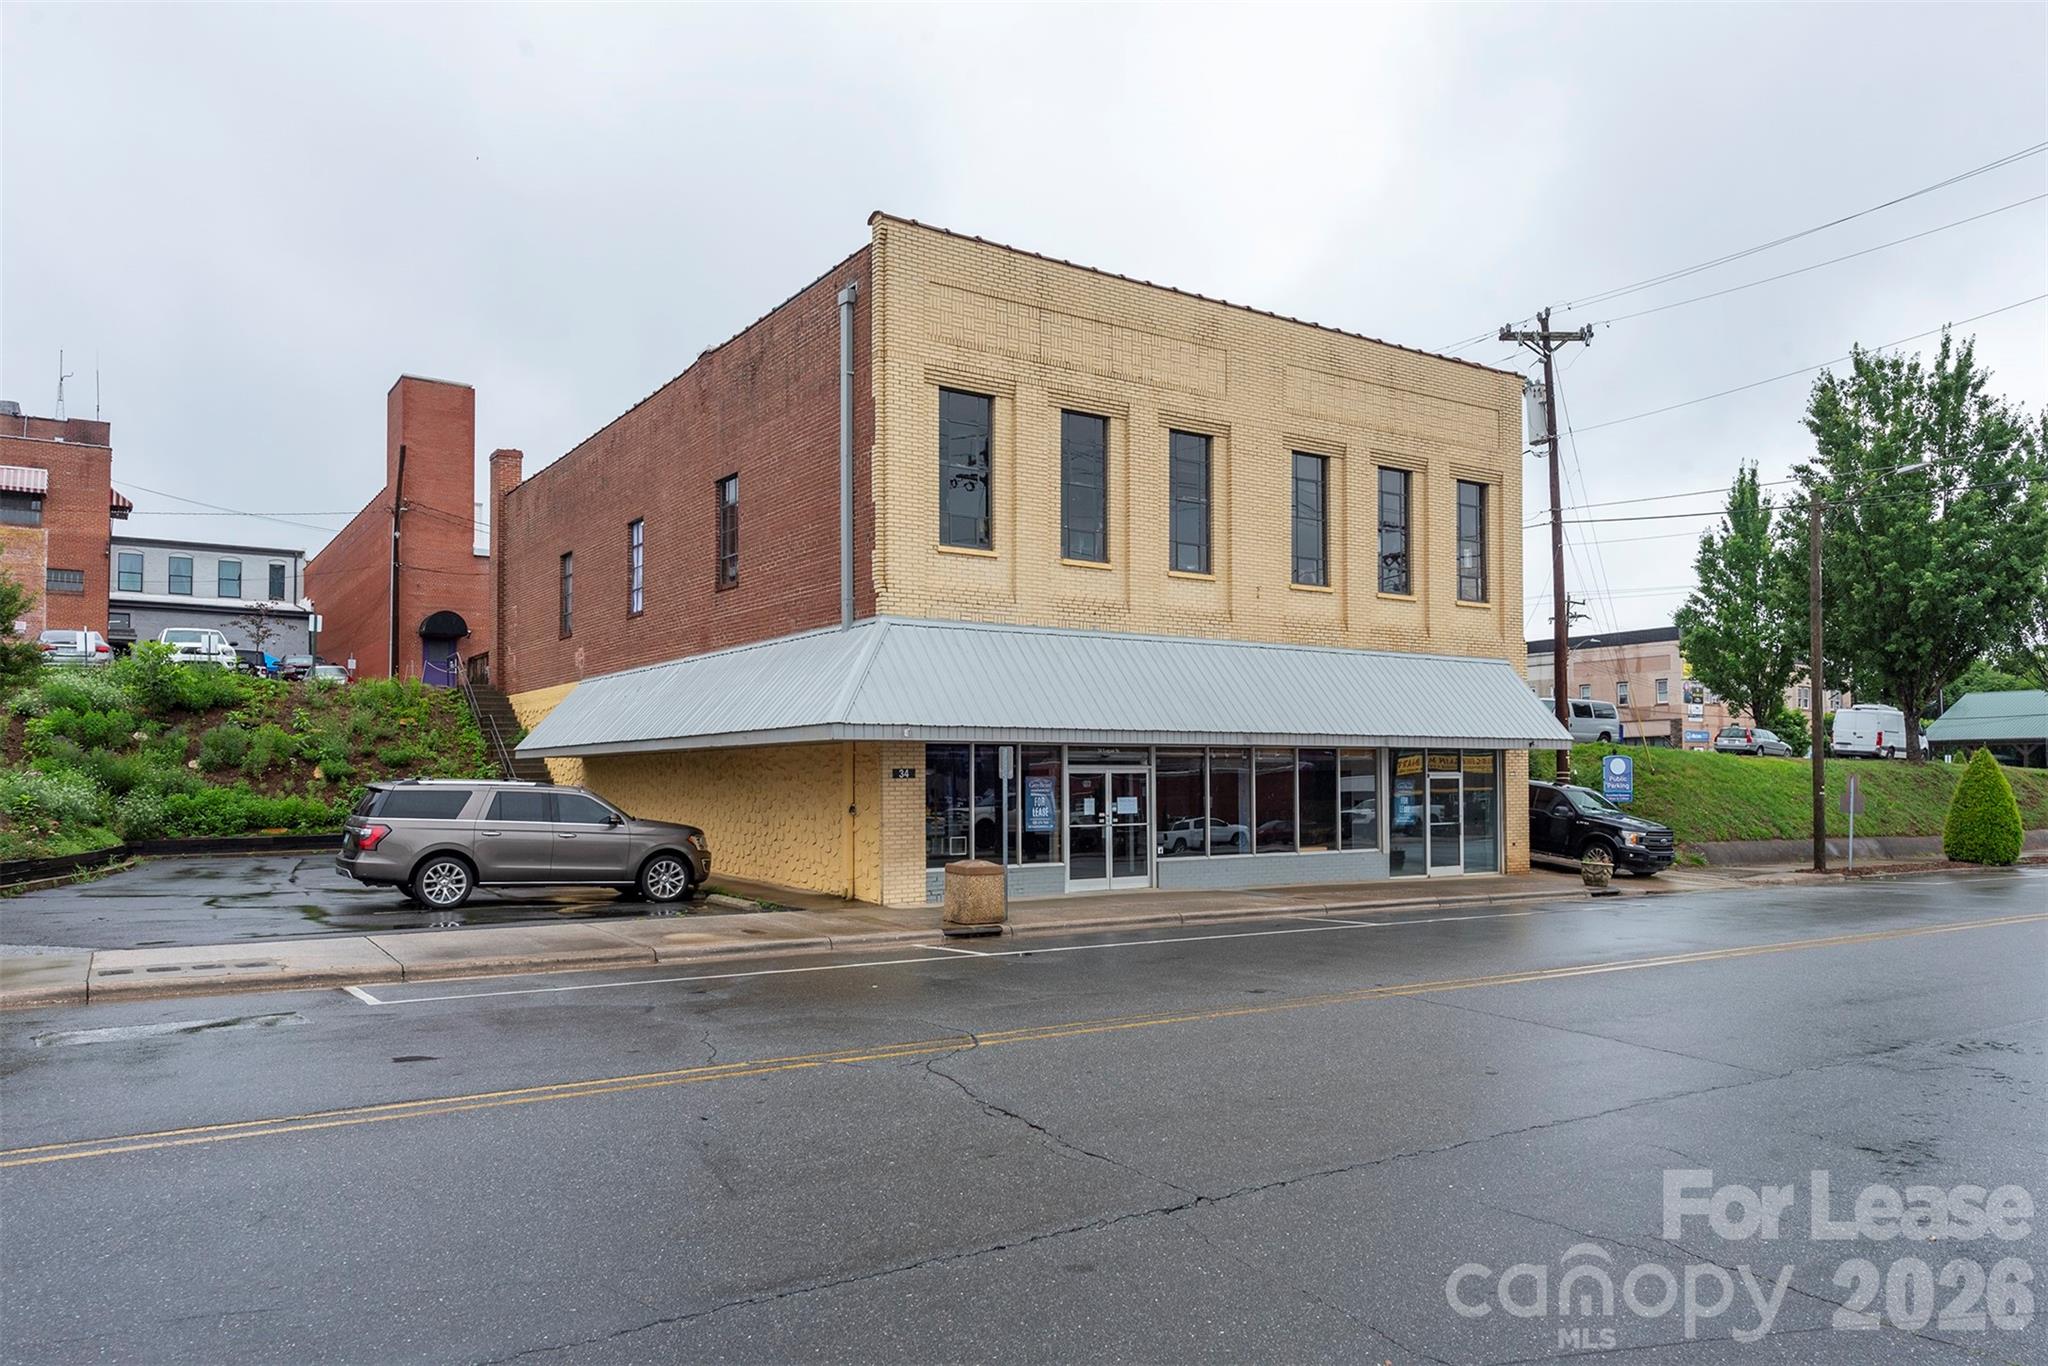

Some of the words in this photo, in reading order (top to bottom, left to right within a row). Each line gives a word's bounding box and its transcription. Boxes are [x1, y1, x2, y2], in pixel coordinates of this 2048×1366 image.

[898, 769, 909, 778] 34
[1034, 797, 1046, 807] FOR
[1032, 807, 1049, 817] LEASE
